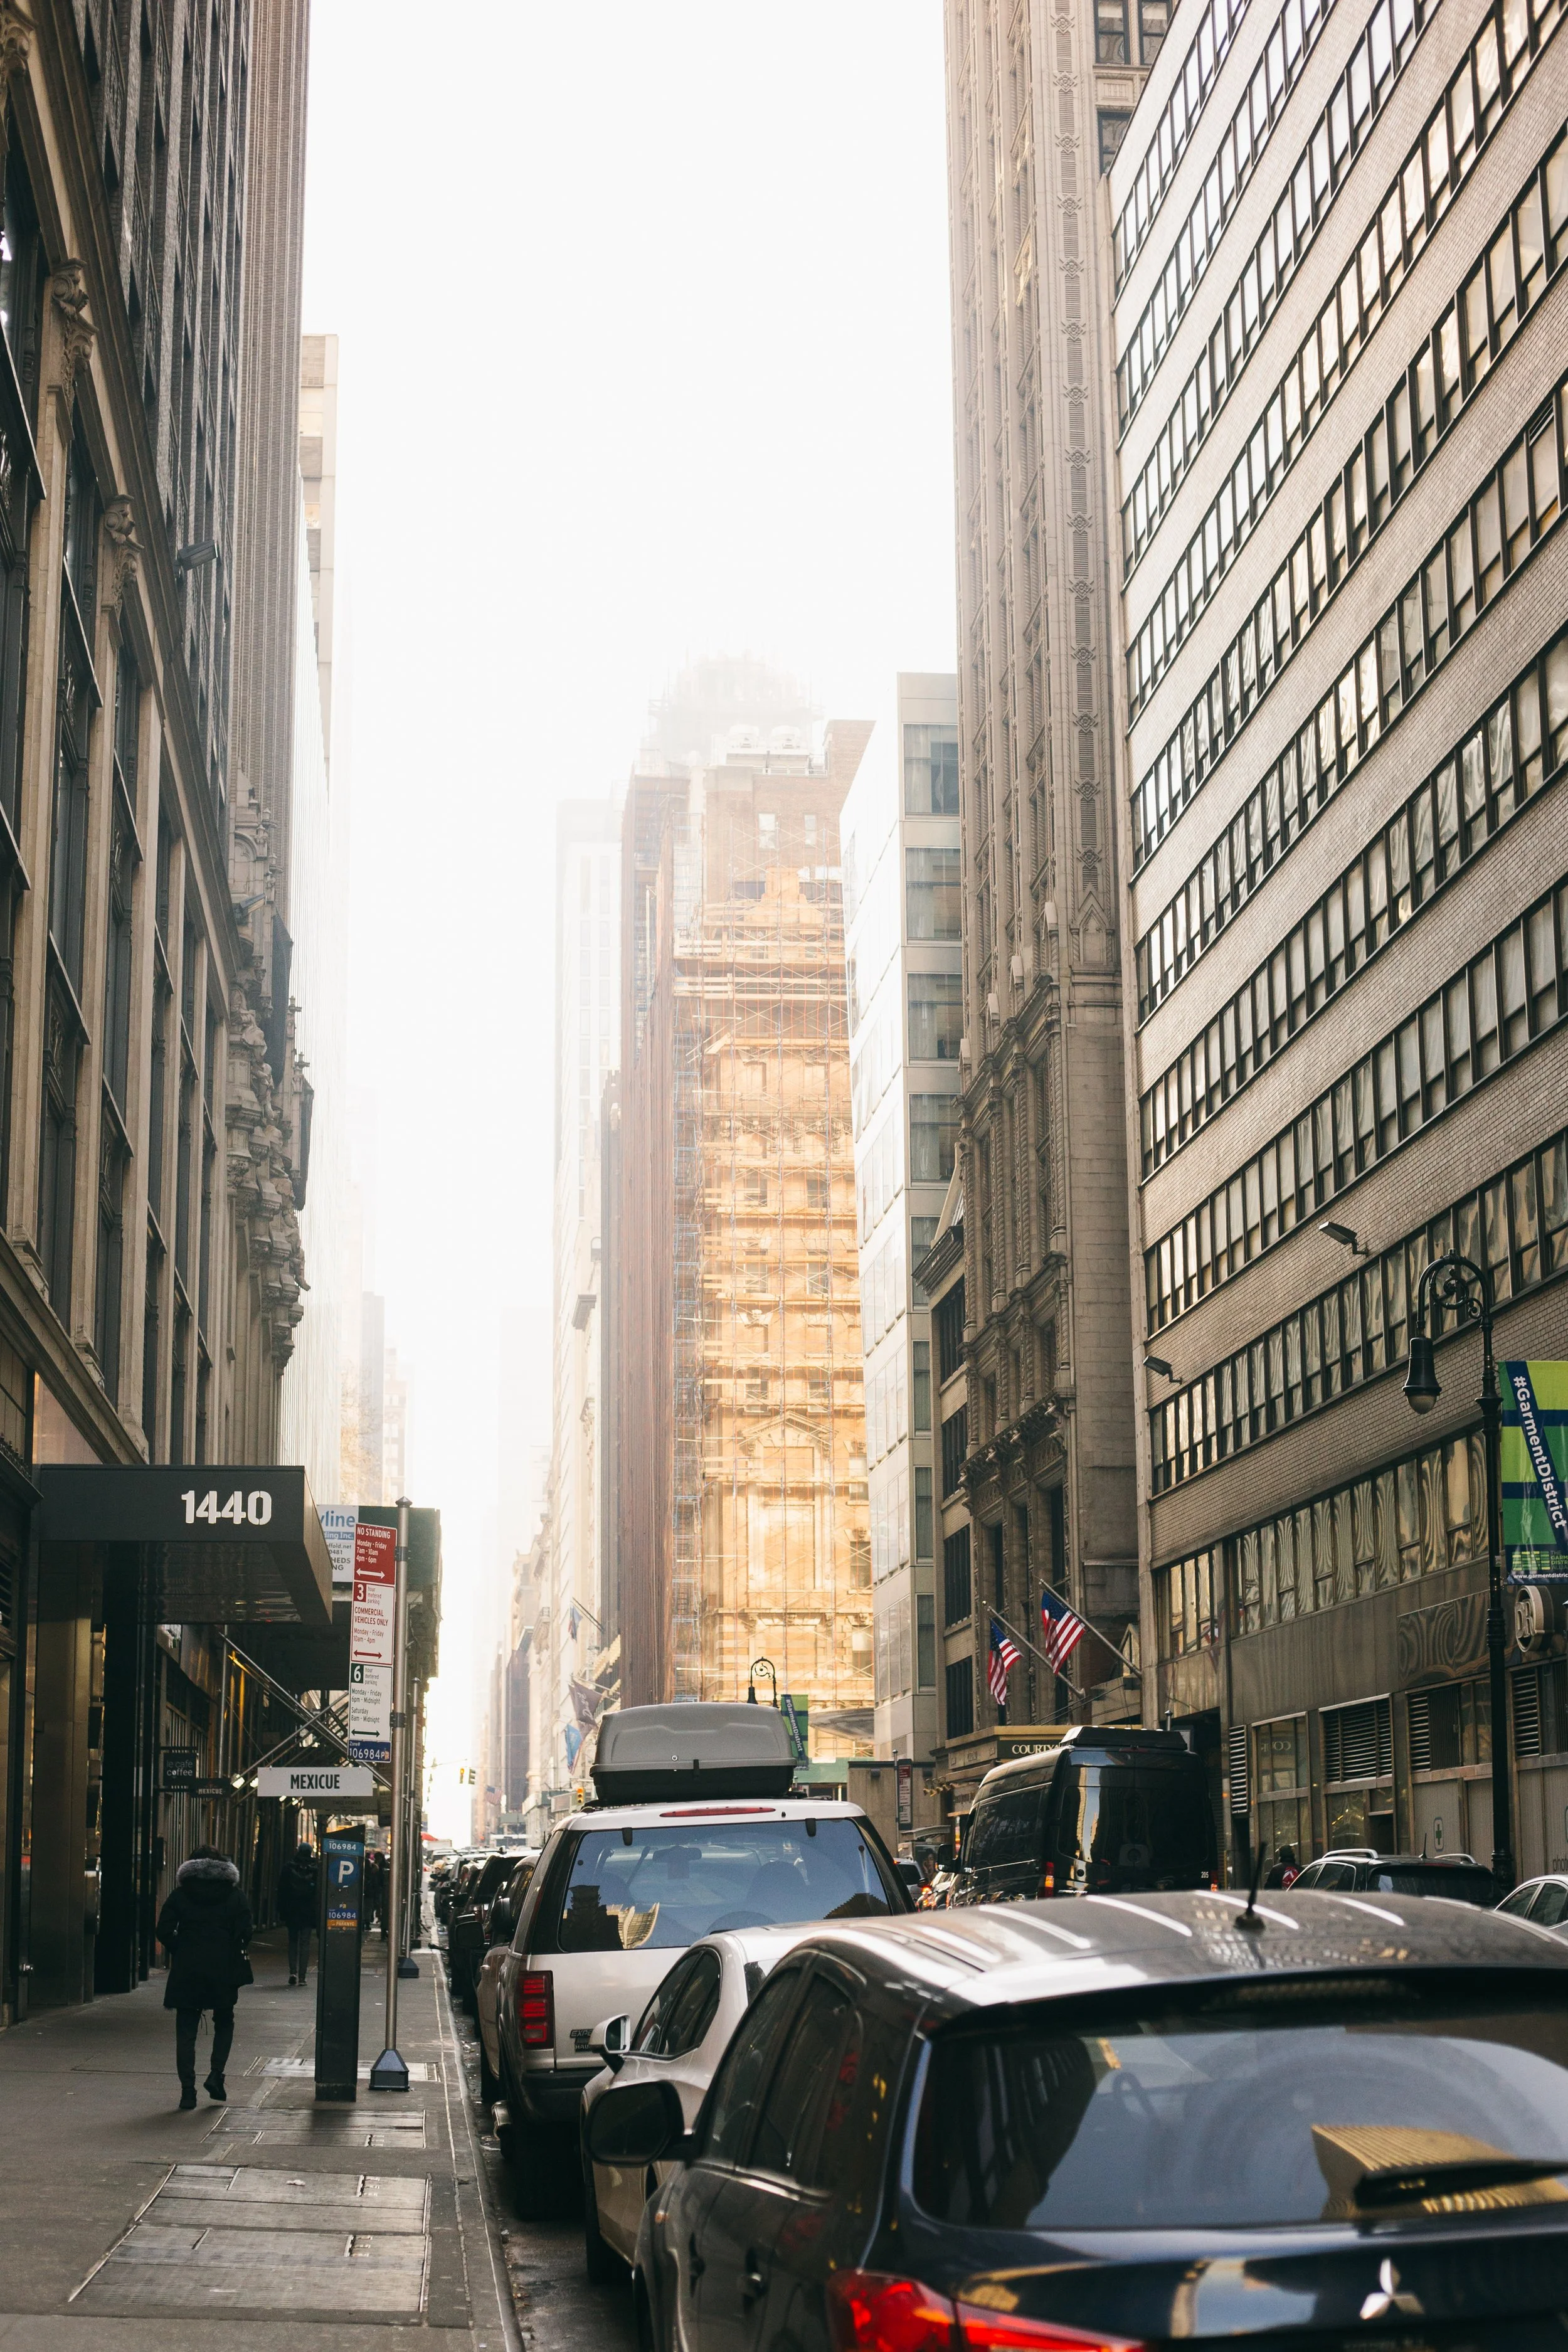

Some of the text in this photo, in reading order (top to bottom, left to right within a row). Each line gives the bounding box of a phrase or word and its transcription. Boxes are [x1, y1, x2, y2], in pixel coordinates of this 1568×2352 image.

[1513, 1376, 1567, 1528] #GarmentDistrict
[181, 1490, 272, 1525] 1440
[357, 1527, 391, 1539] NO STANDING
[357, 1539, 372, 1548] Monday
[375, 1542, 387, 1550] Friday
[368, 1548, 378, 1556] 10am
[356, 1584, 364, 1601] 3
[354, 1606, 384, 1617] COMMERCIAL
[354, 1616, 376, 1624] VEHICLES
[354, 1628, 369, 1636] Monday
[372, 1629, 384, 1638] Friday
[354, 1665, 361, 1682] 6
[352, 1688, 367, 1696] Monday
[364, 1697, 380, 1705] Midnight
[363, 1715, 380, 1724] Midnight
[786, 1699, 803, 1752] #GarmentDistrict
[349, 1748, 379, 1759] 106984
[167, 1768, 193, 1776] coffee
[290, 1774, 340, 1789] MEXICUE
[338, 1861, 354, 1883] P
